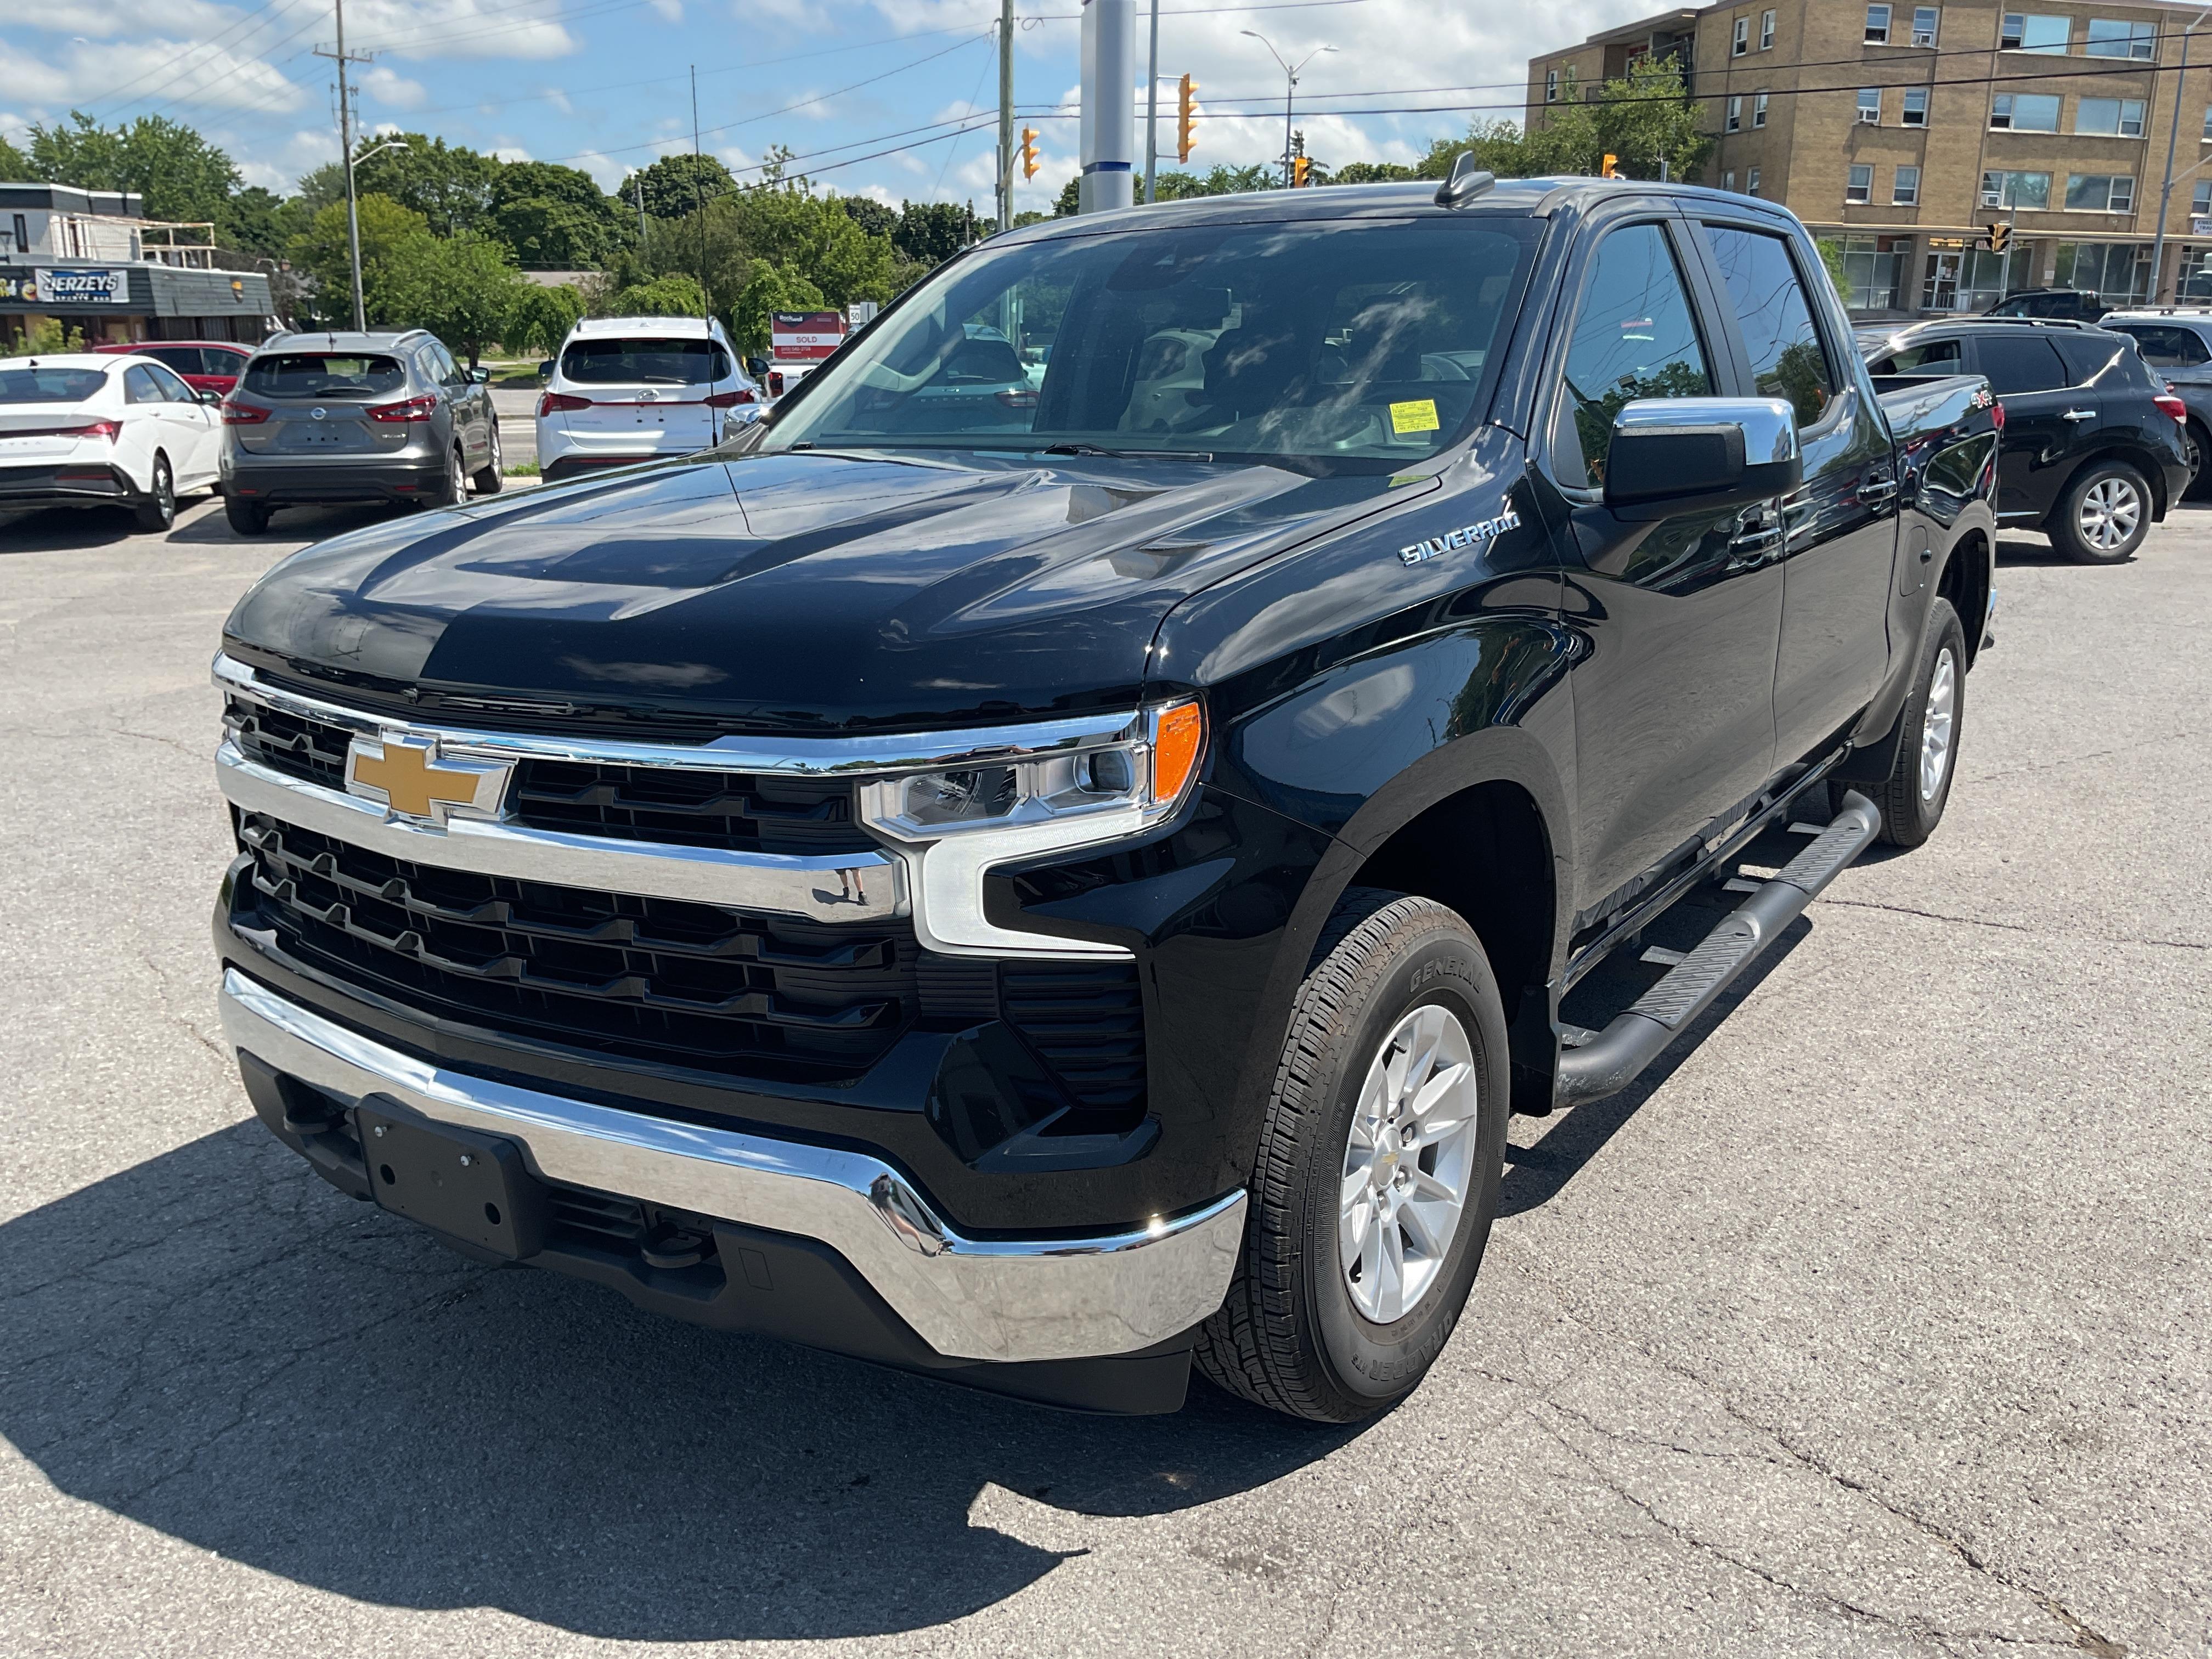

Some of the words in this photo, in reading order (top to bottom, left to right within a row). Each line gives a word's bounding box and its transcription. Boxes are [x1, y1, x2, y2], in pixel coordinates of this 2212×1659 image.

[44, 275, 117, 292] JERZEYS
[851, 313, 860, 321] 50
[1397, 511, 1521, 567] SILVERADO
[1409, 956, 1482, 994] GENERAL
